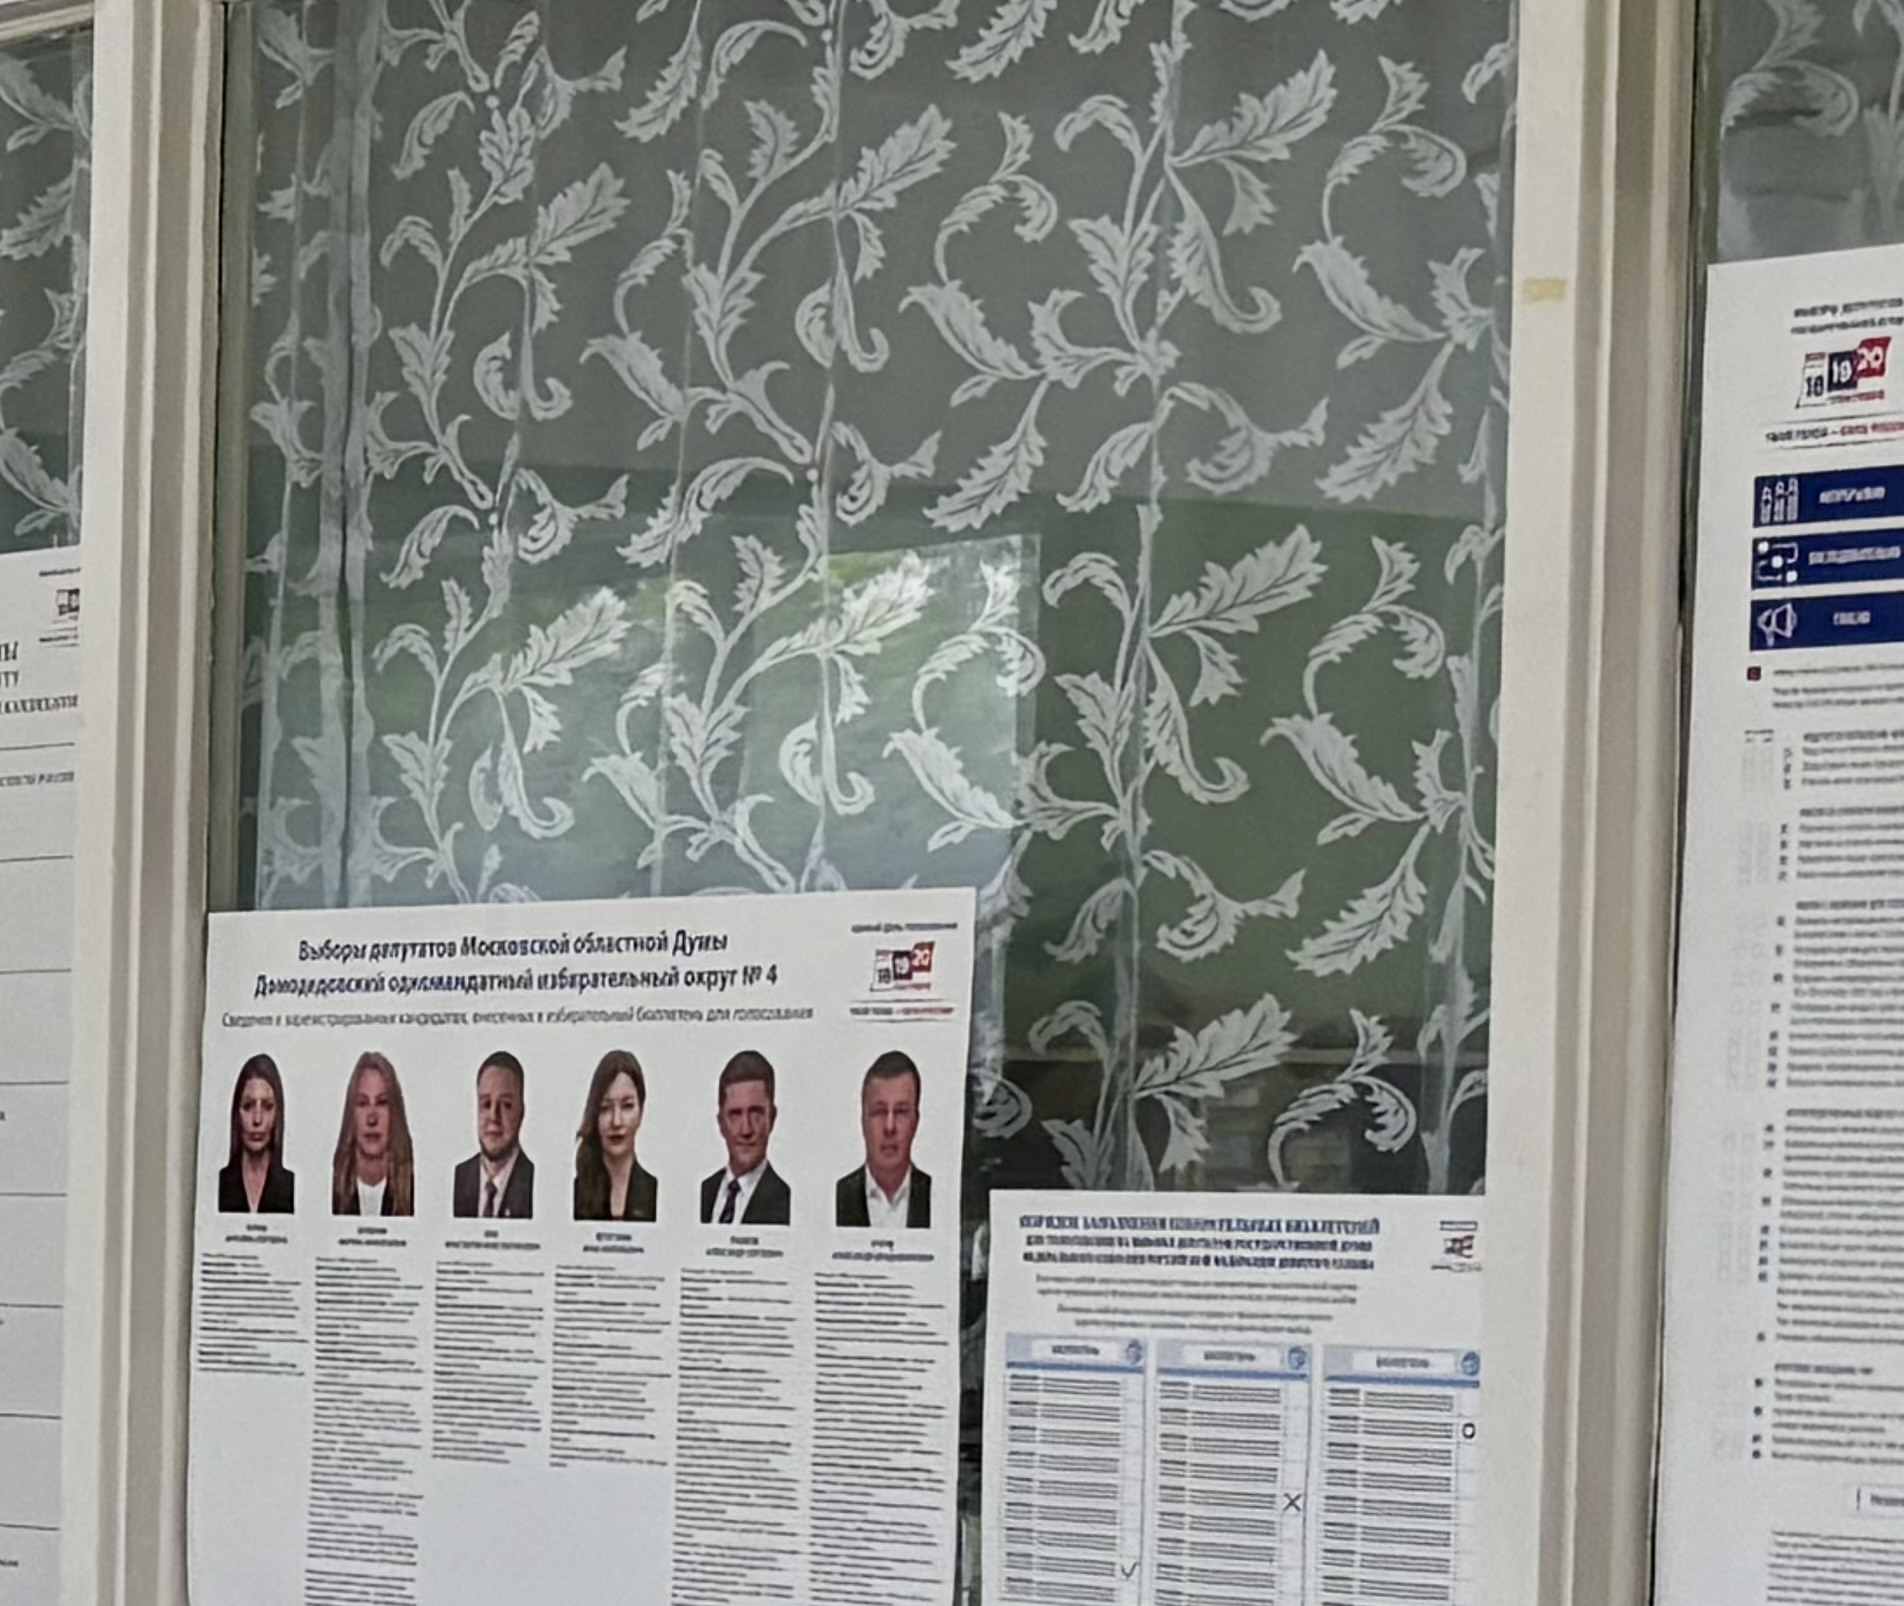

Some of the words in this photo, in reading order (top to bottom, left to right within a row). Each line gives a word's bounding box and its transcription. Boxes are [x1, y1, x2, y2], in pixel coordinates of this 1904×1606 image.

[1857, 347, 1883, 371] 20
[298, 939, 366, 964] Выборы
[369, 941, 456, 962] депутатов
[460, 933, 570, 957] Московской
[573, 931, 668, 954] областной
[672, 930, 728, 956] Думы
[537, 966, 680, 995] избирательный
[684, 966, 738, 992] округ
[742, 965, 763, 985] №
[765, 964, 778, 985] 4
